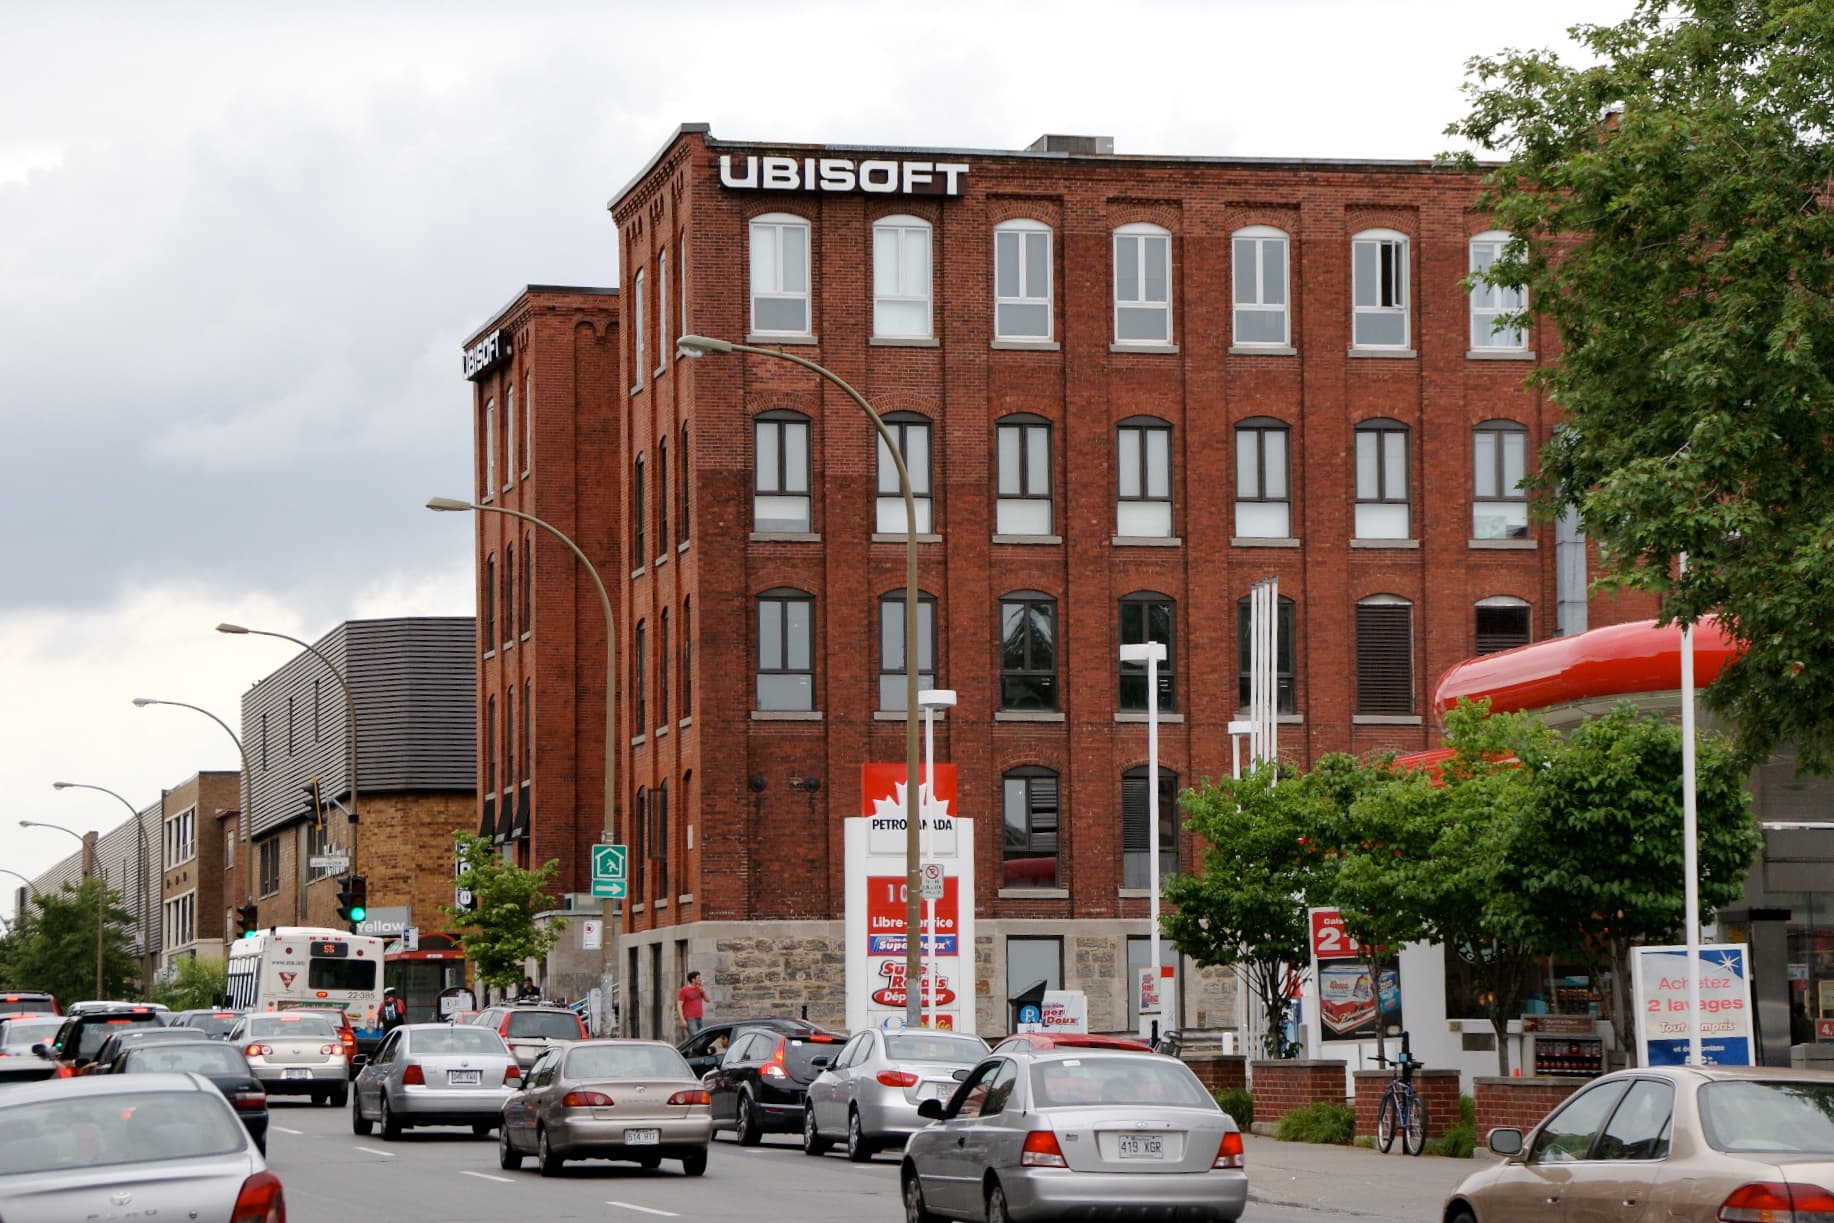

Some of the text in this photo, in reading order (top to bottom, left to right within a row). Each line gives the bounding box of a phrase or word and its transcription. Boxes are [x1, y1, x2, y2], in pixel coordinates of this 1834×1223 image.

[720, 155, 970, 195] UBISOFT
[462, 329, 499, 379] UBISOFT
[872, 819, 907, 831] PETRO
[356, 920, 404, 933] Yellow
[873, 916, 954, 928] Libre-rice
[878, 941, 908, 952] Supe
[881, 962, 929, 976] Sue
[890, 976, 947, 988] Ras
[883, 991, 947, 1004] Dépnur
[1648, 998, 1743, 1013] 2 laages
[1043, 1009, 1064, 1018] per
[1046, 1016, 1077, 1025] Doux
[1660, 1019, 1736, 1034] Tout mpris
[1144, 1141, 1161, 1153] XGR
